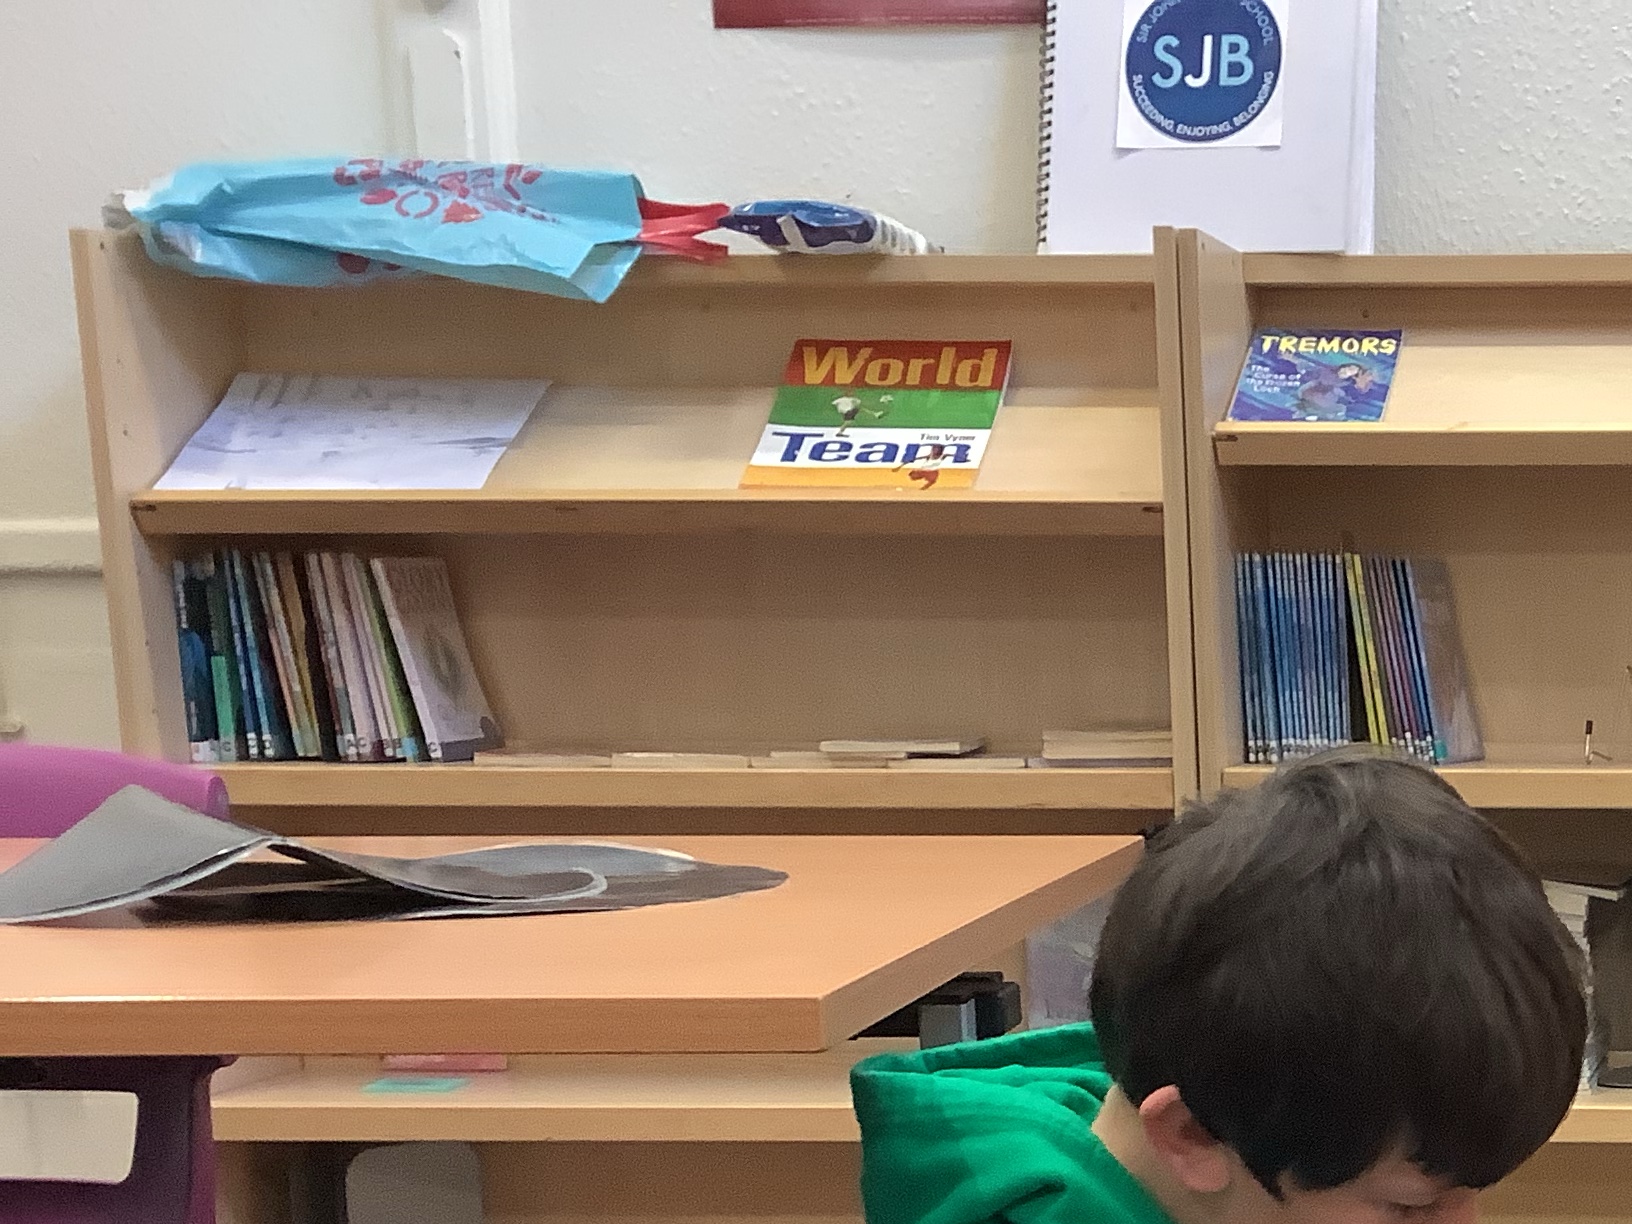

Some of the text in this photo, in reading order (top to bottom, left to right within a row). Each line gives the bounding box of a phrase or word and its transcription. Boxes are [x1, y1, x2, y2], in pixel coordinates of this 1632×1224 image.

[1136, 23, 1152, 43] SIR
[1151, 34, 1254, 88] SJB
[1233, 71, 1274, 127] BELONGING
[1261, 335, 1398, 357] TREMORS
[802, 346, 998, 387] World
[772, 431, 972, 464] Team
